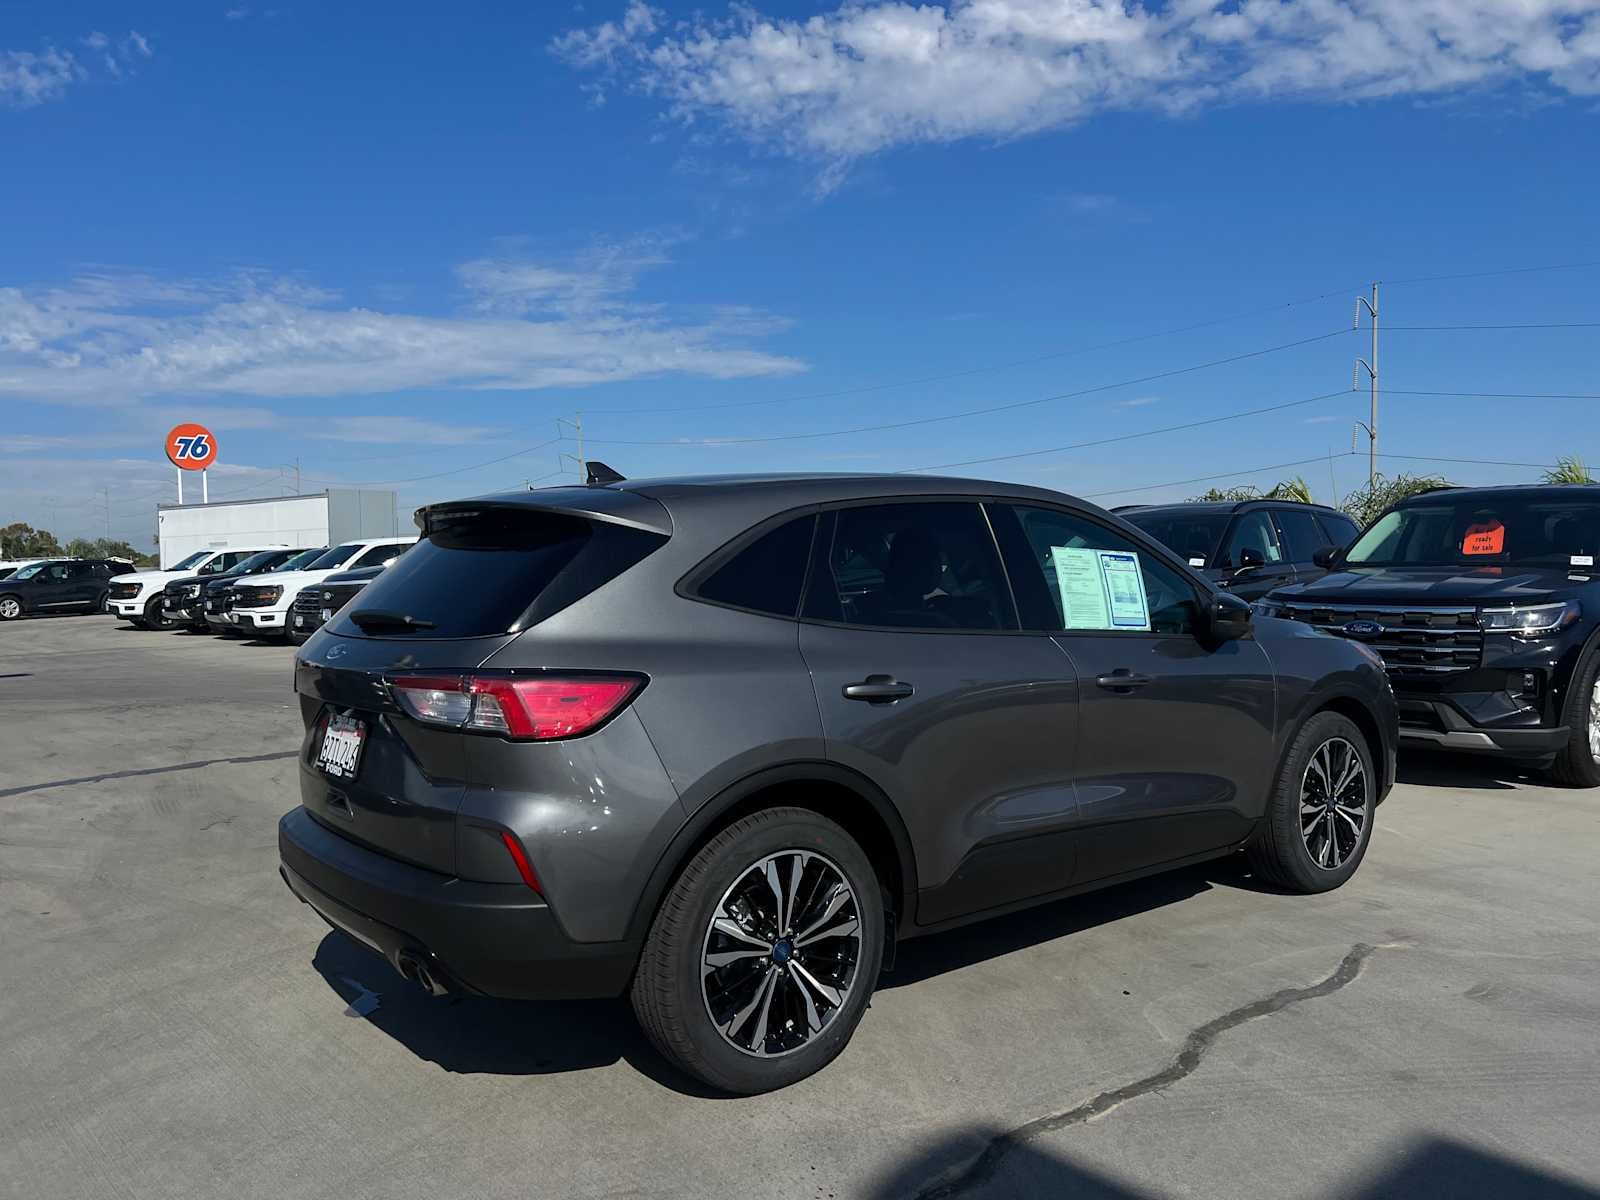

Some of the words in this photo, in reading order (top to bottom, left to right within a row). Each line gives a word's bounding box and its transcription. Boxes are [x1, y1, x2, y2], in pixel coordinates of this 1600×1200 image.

[174, 434, 211, 460] 76
[1475, 536, 1492, 544] ready
[1472, 544, 1480, 552] for
[325, 762, 343, 777] FORD
